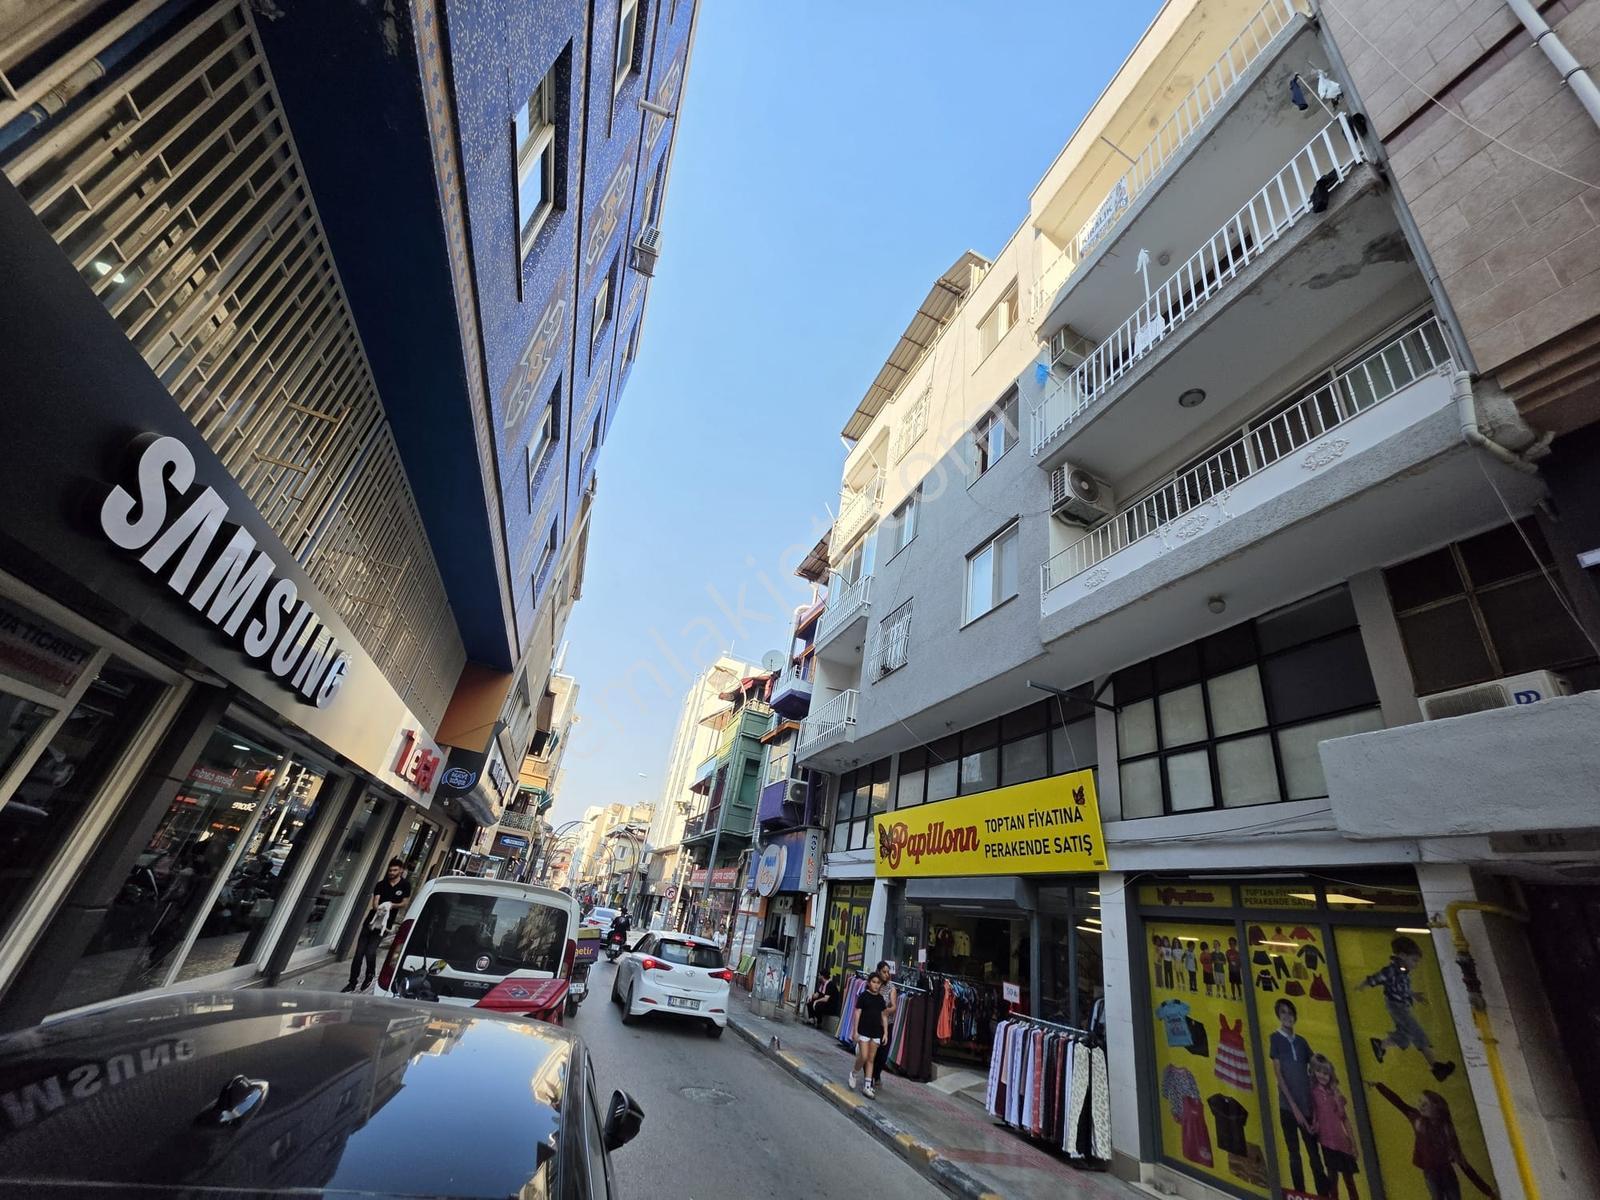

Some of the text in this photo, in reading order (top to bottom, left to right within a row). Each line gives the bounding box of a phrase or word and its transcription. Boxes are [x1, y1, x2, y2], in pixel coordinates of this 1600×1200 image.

[101, 434, 352, 708] SAMSUNG
[984, 806, 1083, 833] TOPTAN FİYATINA
[888, 821, 980, 870] Papillonn
[984, 833, 1093, 858] PERAKENDE SATIŞ
